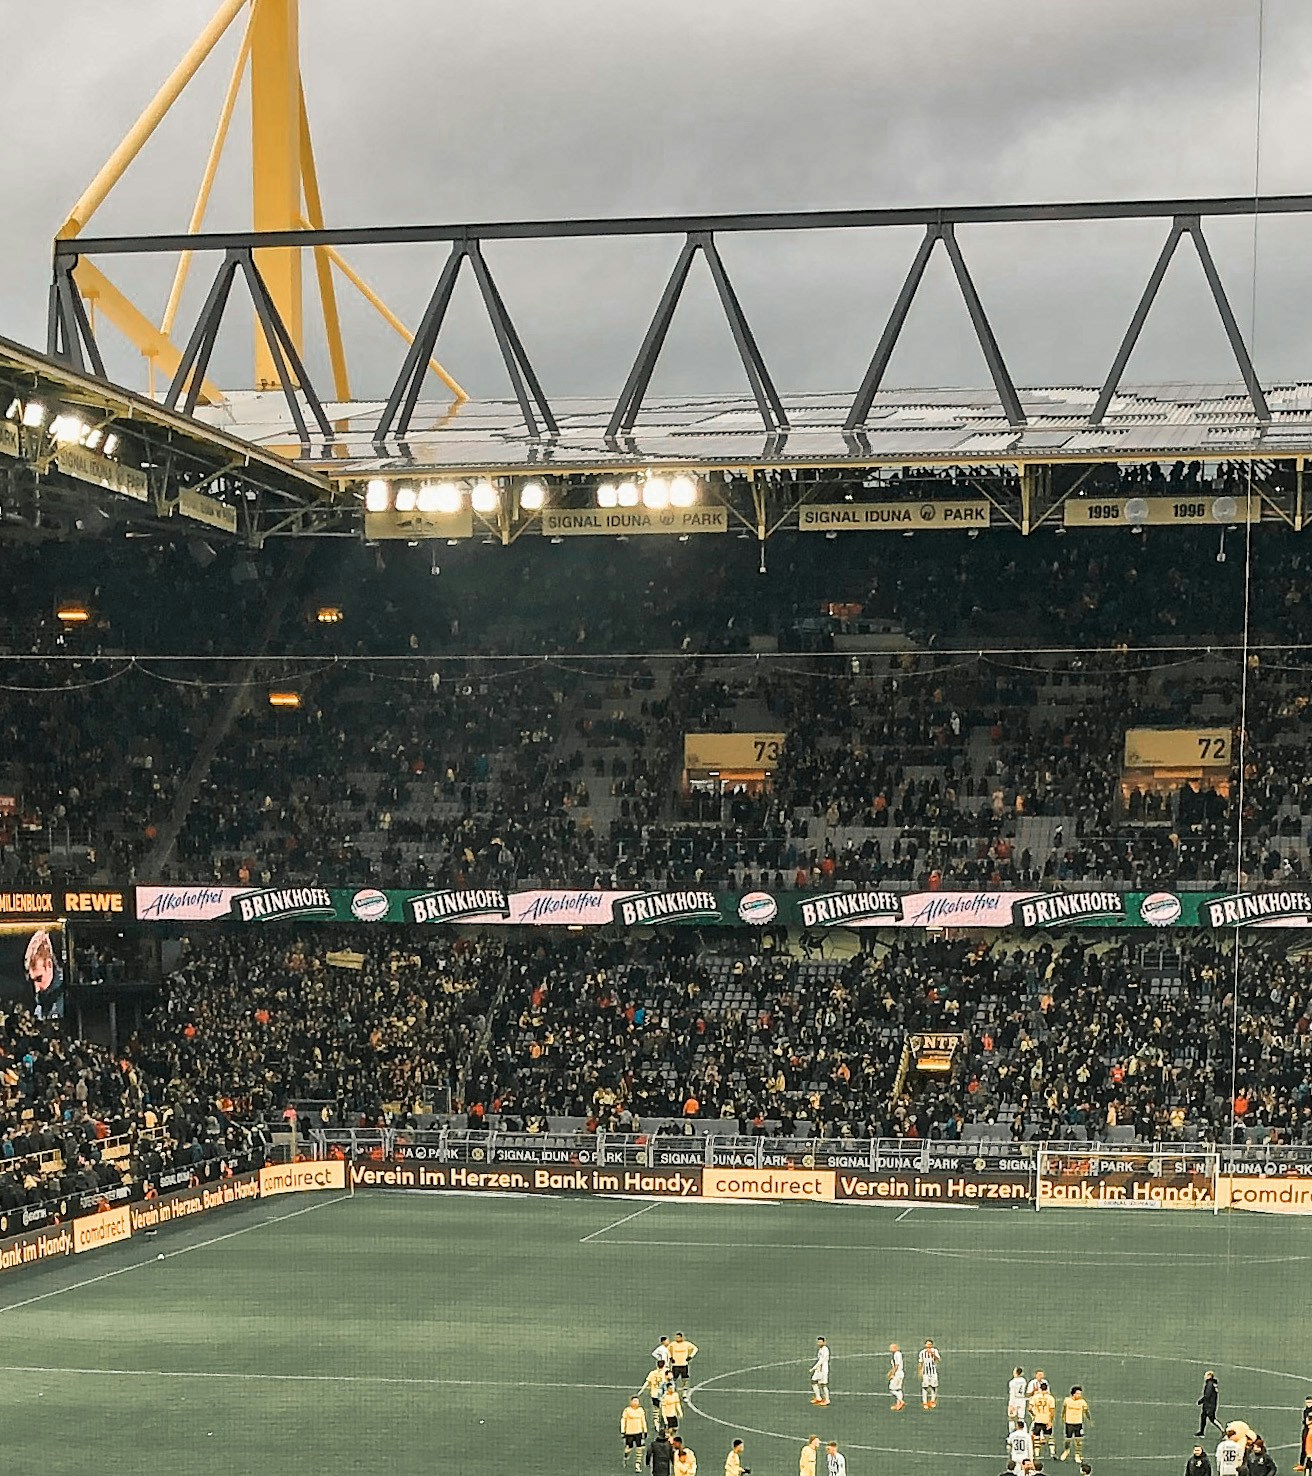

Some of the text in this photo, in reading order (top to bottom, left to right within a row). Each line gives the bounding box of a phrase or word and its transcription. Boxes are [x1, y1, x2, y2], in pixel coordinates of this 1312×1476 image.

[805, 507, 985, 524] SIGNAL IDUNA PARK
[1088, 504, 1119, 520] 1995
[1173, 503, 1205, 518] 1996
[549, 513, 722, 528] SIGNAL IDUNA PARK
[754, 741, 779, 762] 73
[1198, 738, 1226, 759] 72
[65, 893, 124, 912] REWE
[497, 1150, 575, 1163] SIGNAL IDUN
[660, 1153, 741, 1166] SIGNAL DUNA
[828, 1156, 871, 1168] SIGNAL
[999, 1161, 1037, 1171] SIGNA
[1101, 1162, 1133, 1172] PARK
[264, 1167, 332, 1190] comdirect
[352, 1164, 697, 1195] Verein im Herzen. Bank im Handy.
[716, 1175, 822, 1195] comdirect
[841, 1176, 1212, 1202] Verein im Herzen. Bank im Handy.
[131, 1179, 259, 1230] Verein im Herzen. Bank im Handy.
[81, 1217, 126, 1246] comdirect
[22, 1241, 37, 1262] im
[38, 1230, 74, 1256] Handy.
